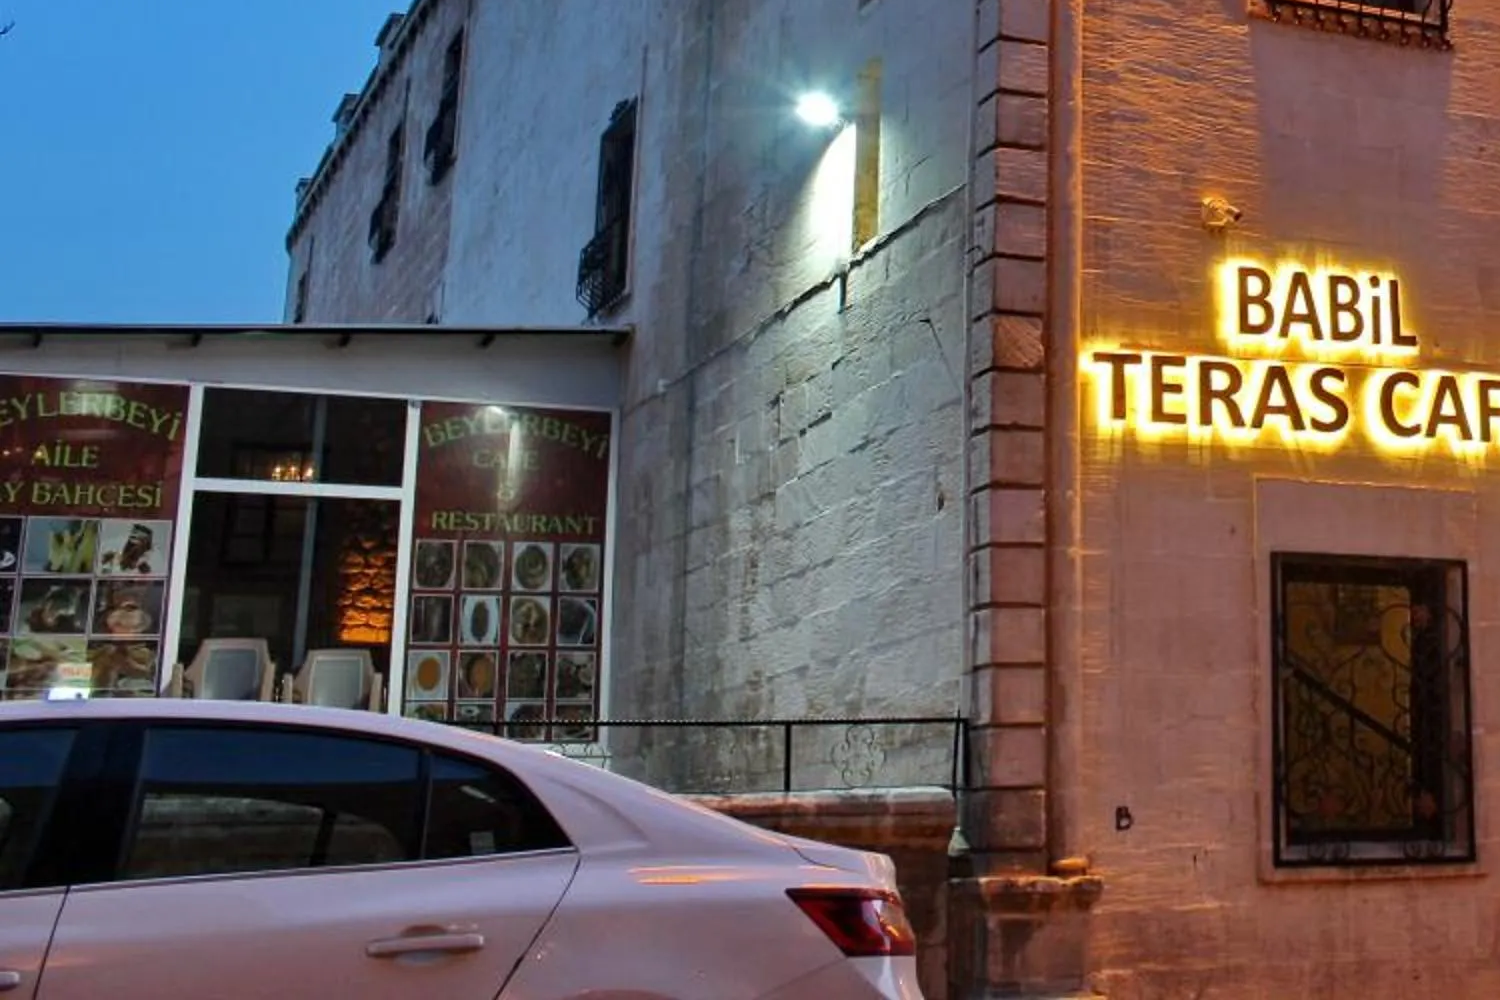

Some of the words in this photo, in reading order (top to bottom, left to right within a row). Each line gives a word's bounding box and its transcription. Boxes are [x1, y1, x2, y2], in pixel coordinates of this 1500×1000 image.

[1092, 351, 1351, 434] TERAS
[31, 438, 100, 468] AİLE
[472, 450, 541, 471] CAE
[31, 479, 164, 513] BAHÇESİ
[430, 509, 598, 537] RESTAURANT
